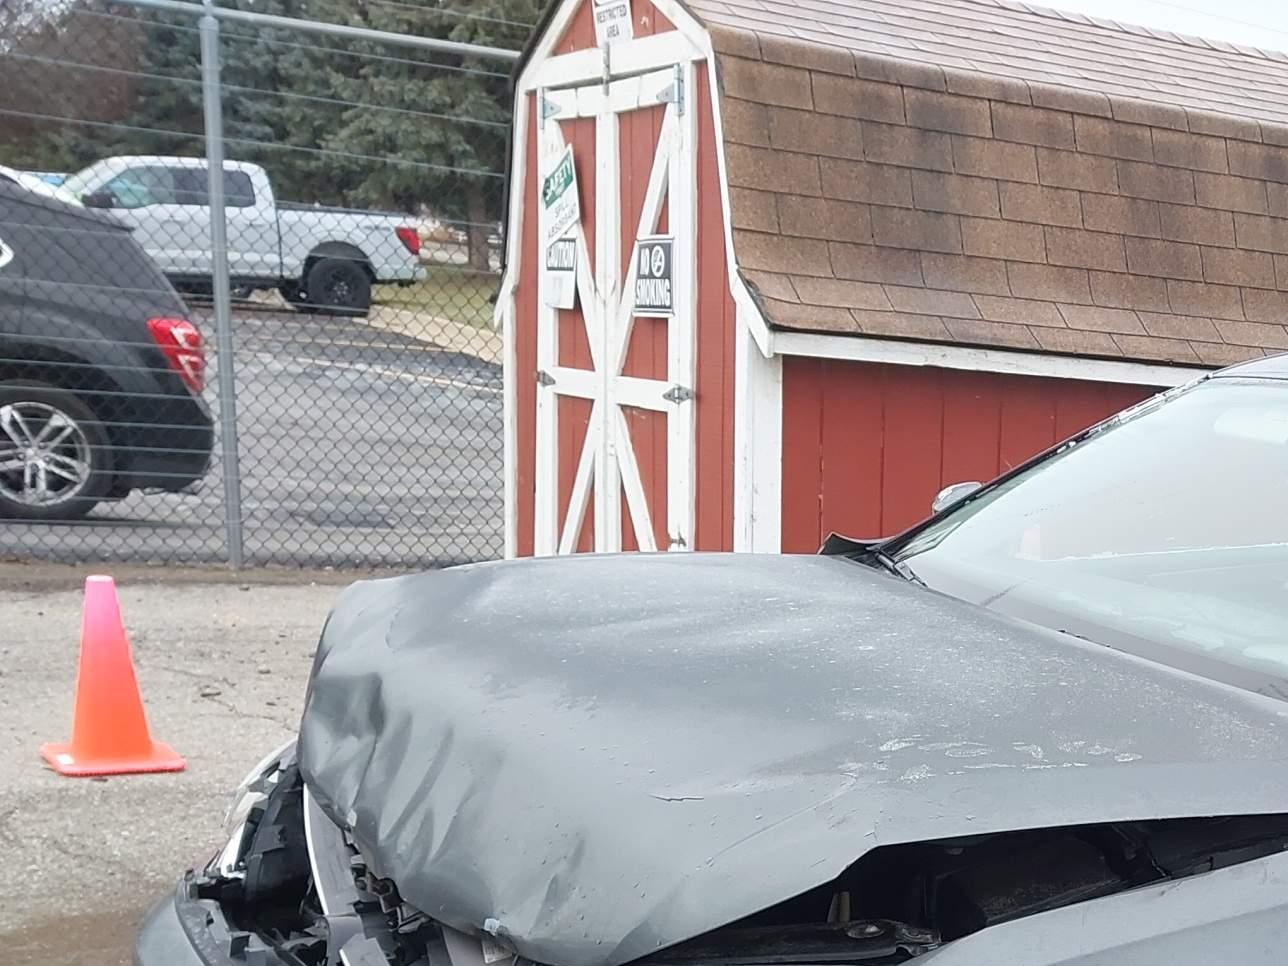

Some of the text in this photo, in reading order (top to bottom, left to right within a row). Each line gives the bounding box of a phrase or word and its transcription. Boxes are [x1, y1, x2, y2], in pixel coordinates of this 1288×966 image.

[596, 4, 627, 23] RESTRICTED
[606, 24, 620, 38] AREA
[543, 157, 573, 200] SAFETY
[639, 247, 650, 276] NO
[636, 278, 671, 307] SMOKING
